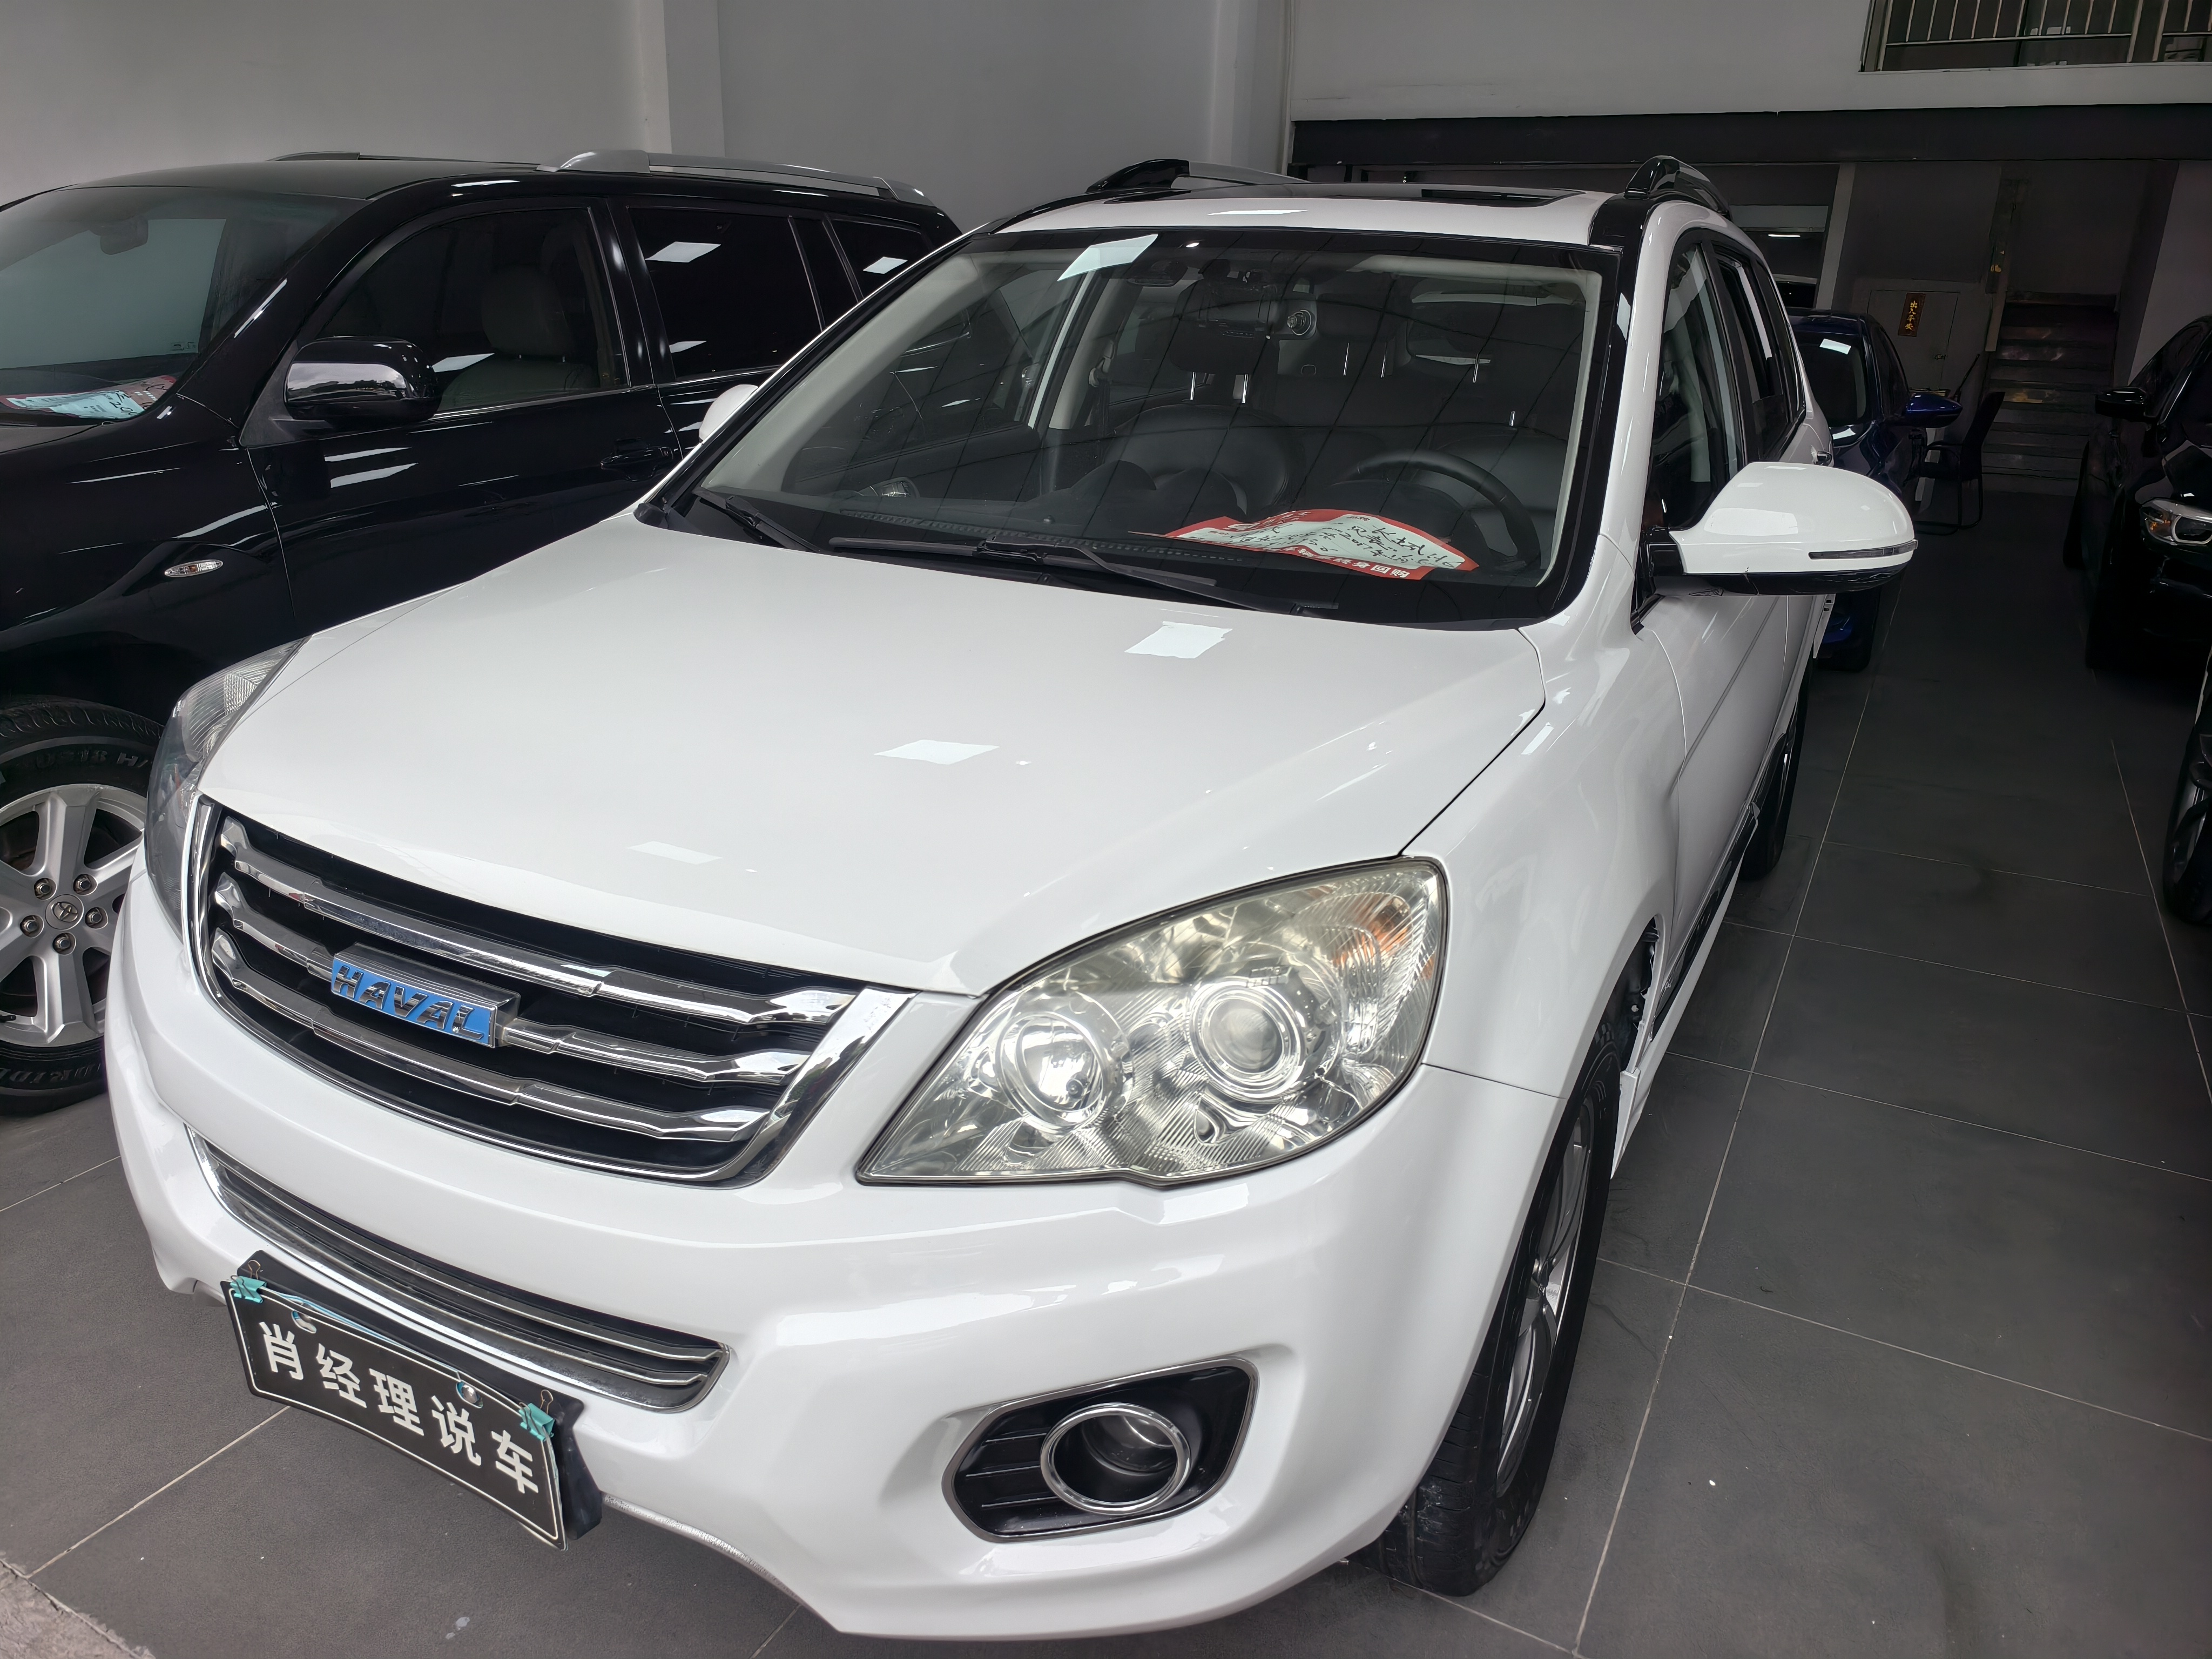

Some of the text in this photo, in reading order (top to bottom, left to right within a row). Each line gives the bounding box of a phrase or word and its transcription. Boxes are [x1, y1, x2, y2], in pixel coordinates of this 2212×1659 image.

[1905, 300, 1918, 331] 出入平安
[333, 965, 484, 1040] HAVAL
[260, 1321, 539, 1494] 肖经理说车
